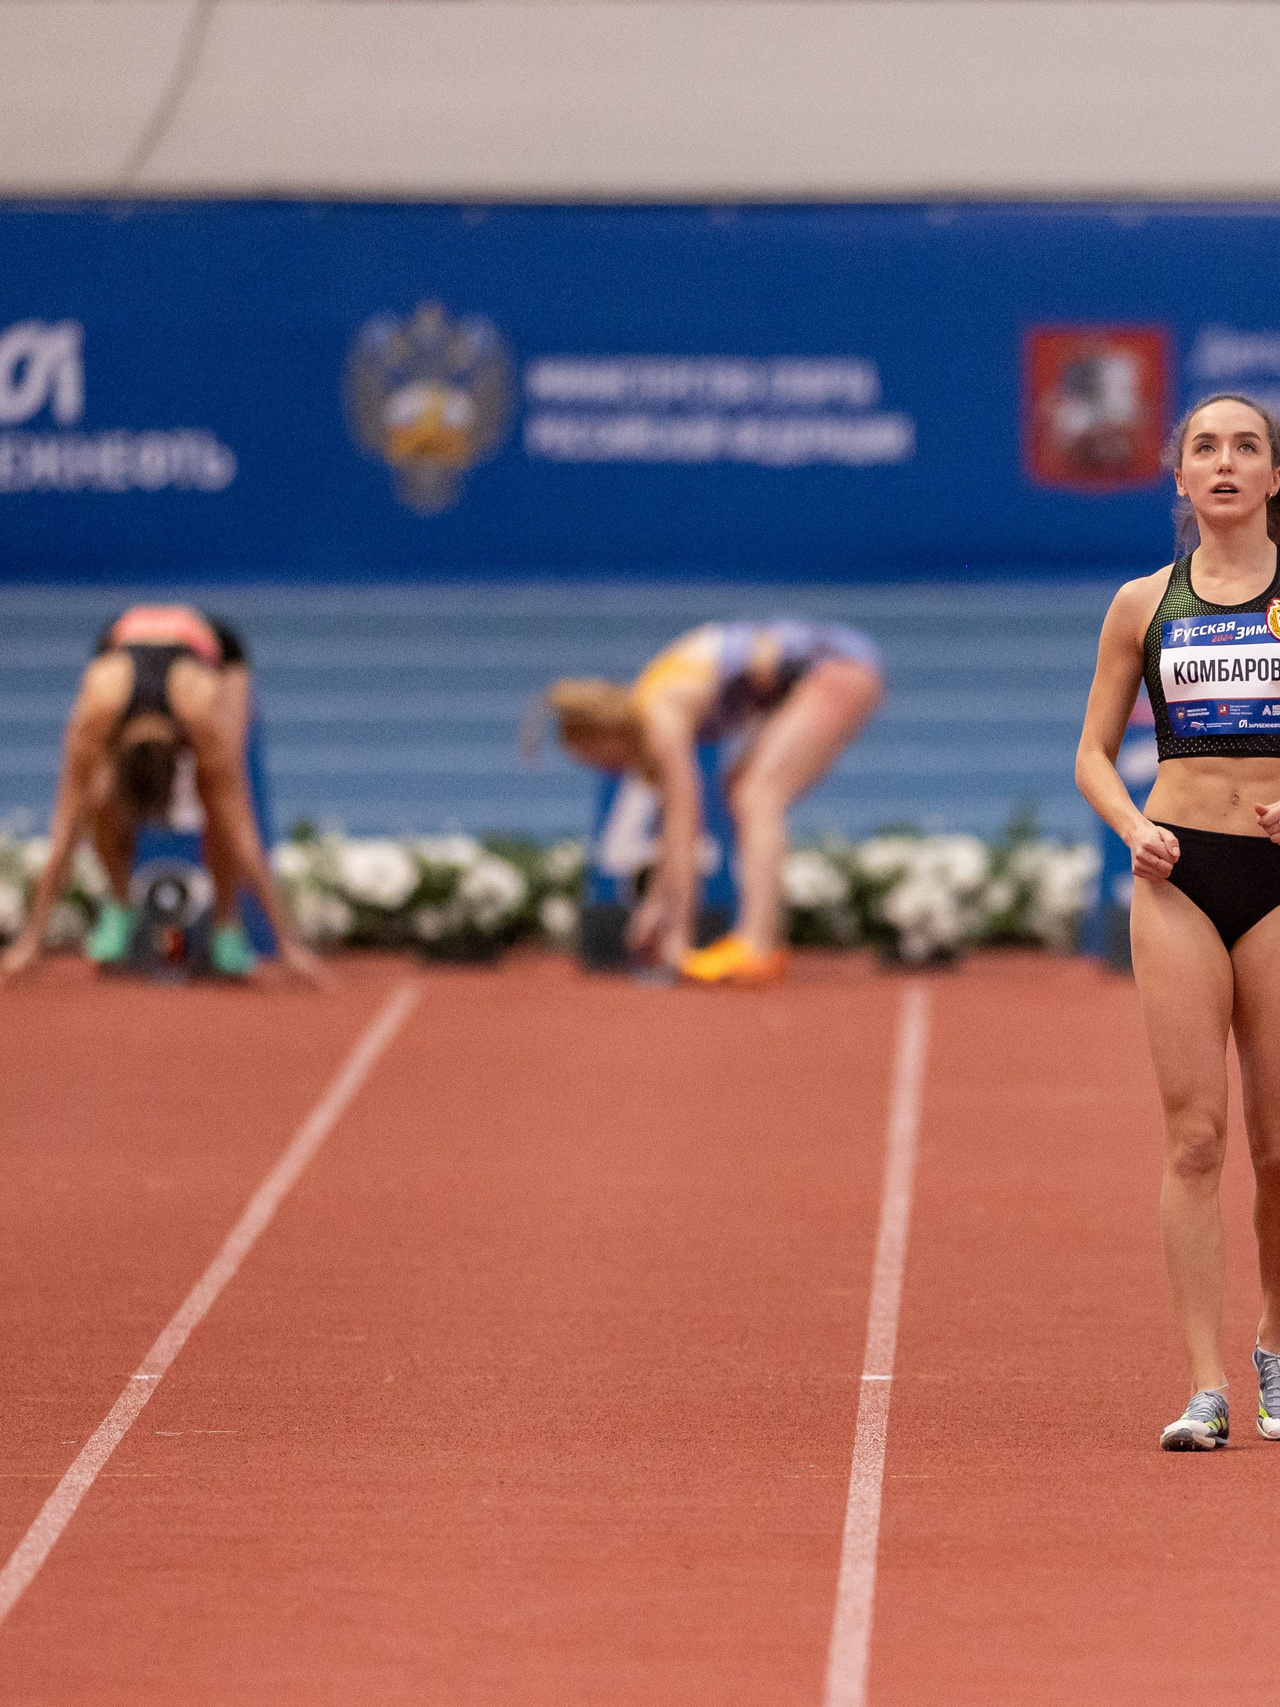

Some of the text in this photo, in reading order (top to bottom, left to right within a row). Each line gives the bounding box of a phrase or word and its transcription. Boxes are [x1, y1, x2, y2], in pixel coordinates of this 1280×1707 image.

[1173, 621, 1271, 642] Русская Зим
[1211, 633, 1233, 643] 2024
